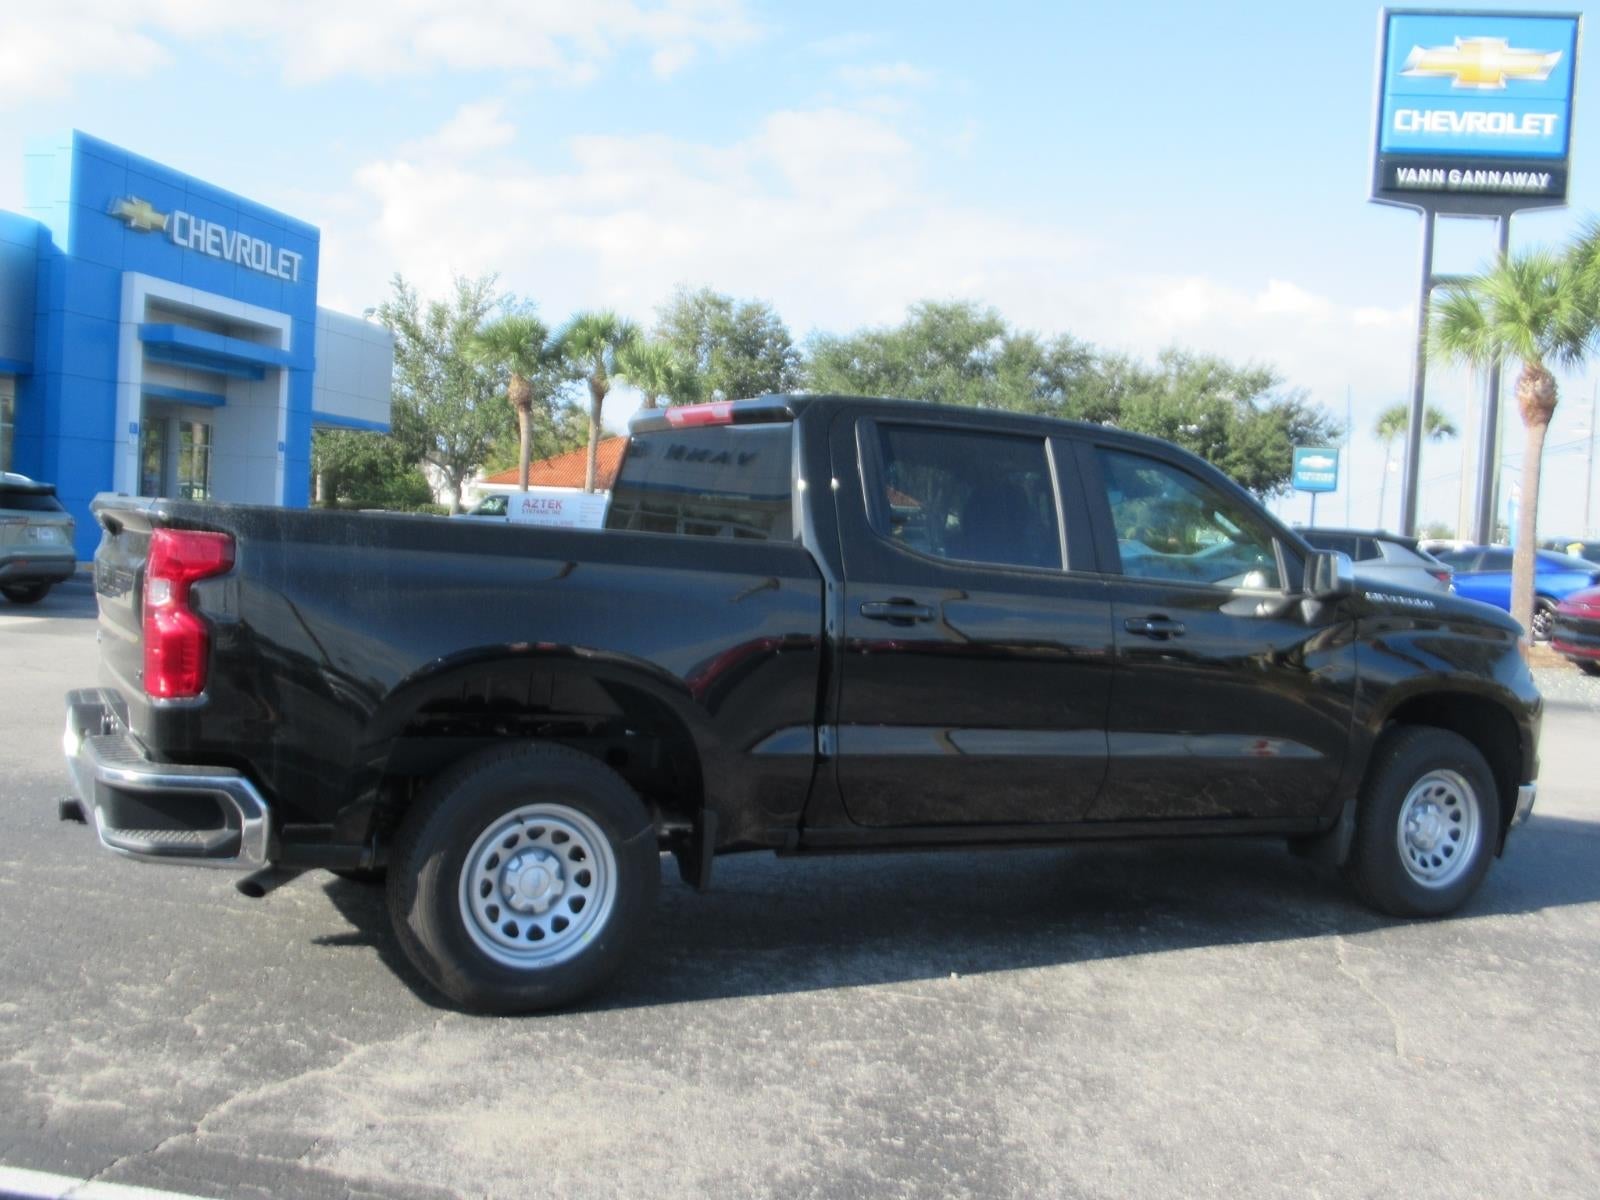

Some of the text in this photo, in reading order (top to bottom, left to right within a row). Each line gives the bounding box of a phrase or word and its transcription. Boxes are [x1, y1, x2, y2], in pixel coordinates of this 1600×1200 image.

[1394, 109, 1559, 135] CHEVROLET
[1397, 167, 1549, 188] VANN GANNAWAY
[173, 210, 302, 282] CHEVROLET
[522, 499, 562, 509] AZTEK
